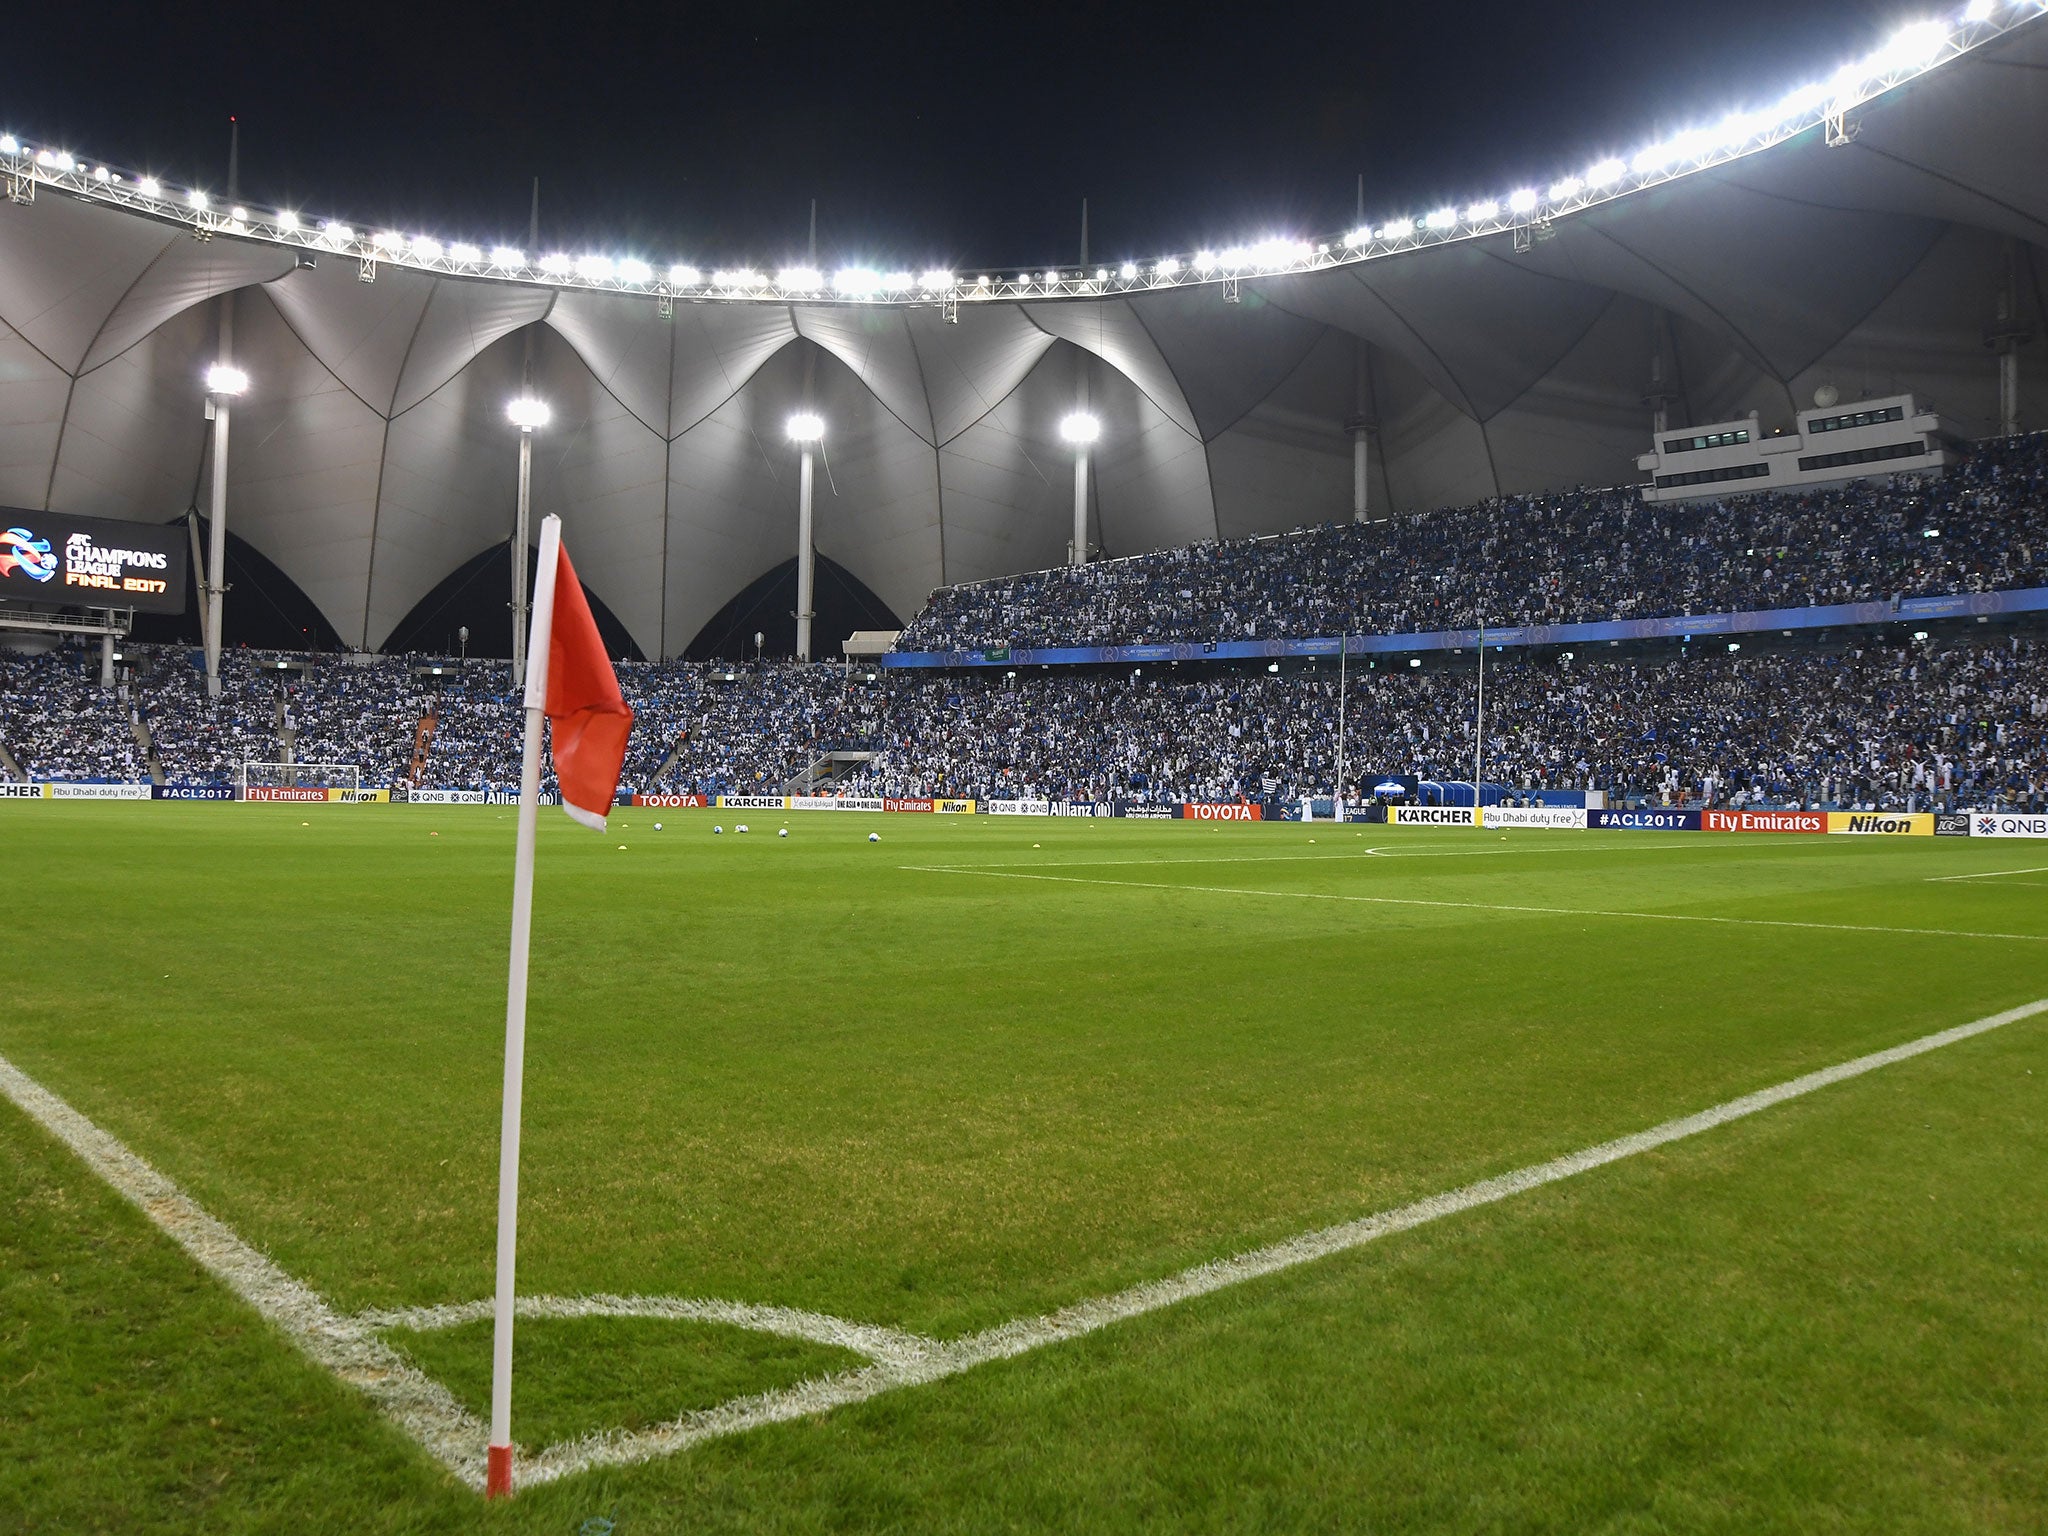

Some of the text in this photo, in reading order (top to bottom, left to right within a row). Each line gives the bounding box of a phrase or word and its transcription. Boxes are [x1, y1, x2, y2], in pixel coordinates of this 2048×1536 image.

[66, 533, 92, 546] AFC
[65, 544, 167, 570] CHAMPIONS
[66, 559, 121, 577] LEAGUE
[65, 573, 167, 594] FINAL 2017
[53, 787, 138, 798] Abu Dhabi duty free
[161, 788, 232, 799] #ACL2017
[248, 788, 324, 801] Fly Emirates
[422, 793, 445, 802] QNB
[462, 794, 483, 803] QNB
[640, 795, 699, 807] TOYOTA
[725, 797, 783, 807] KÄRCHER
[837, 800, 882, 809] ONE ASIA ONE GOAL
[886, 799, 932, 813] Fly Emirates
[942, 801, 967, 813] Nikon
[999, 803, 1017, 812] QNB
[1030, 803, 1048, 813] QNB
[1050, 801, 1093, 817] Allianz
[1191, 804, 1252, 820] TOYOTA
[1343, 807, 1367, 816] LEAGUE
[1398, 809, 1472, 823] KÄRCHER
[1483, 813, 1572, 825] Abu Dhabi duty free
[1599, 813, 1687, 827] #ACL2017
[1709, 813, 1821, 832] Fly Emirates
[1848, 815, 1911, 833] Nikon
[2001, 819, 2047, 834] QNB
